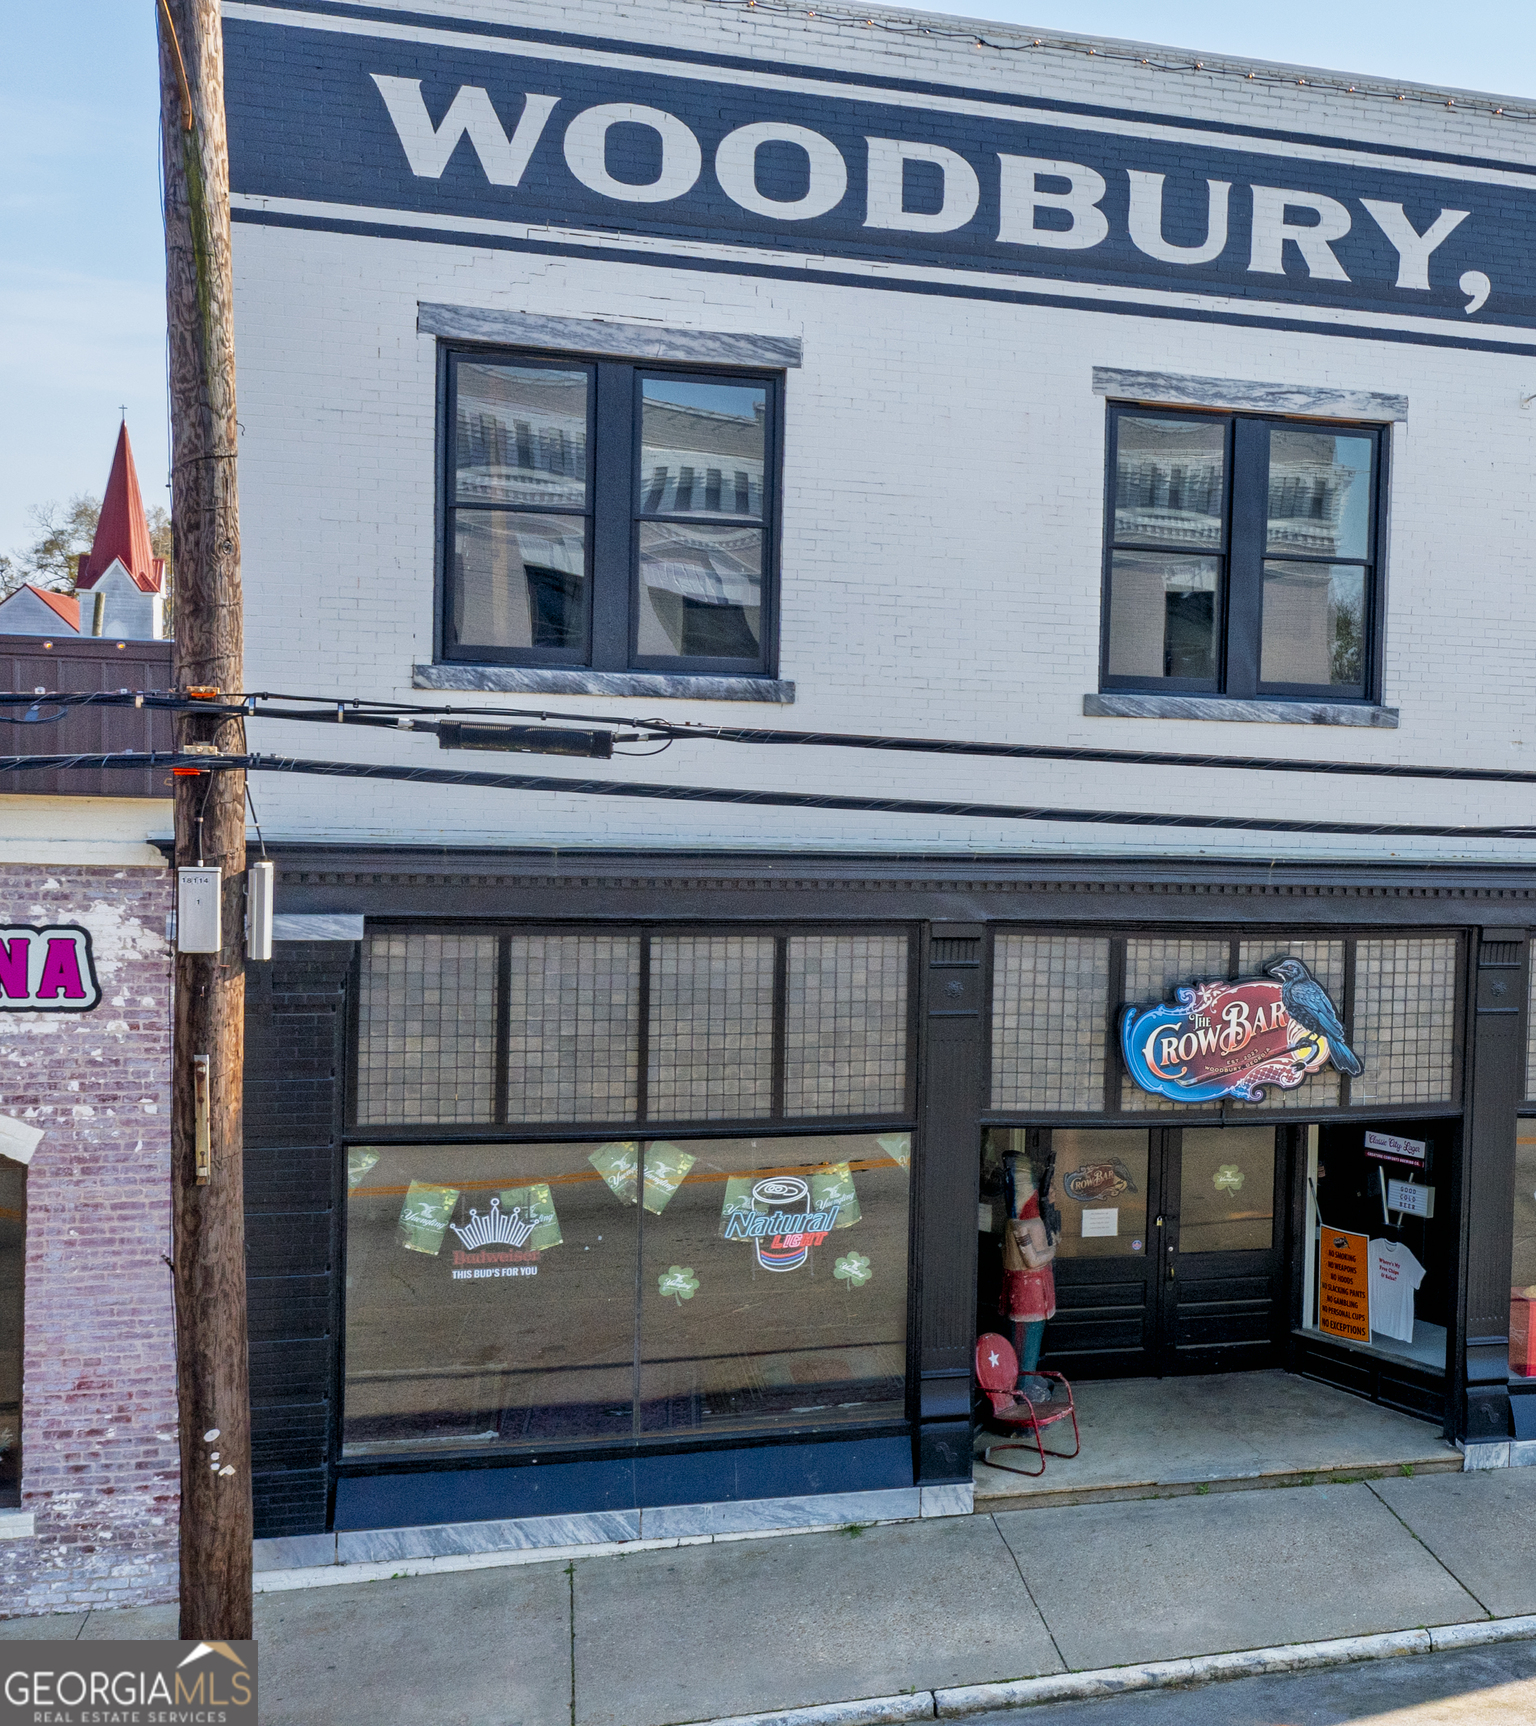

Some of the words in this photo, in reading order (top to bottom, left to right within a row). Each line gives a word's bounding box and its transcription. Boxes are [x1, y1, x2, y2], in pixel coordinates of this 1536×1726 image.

[369, 73, 1491, 315] WOODBURY,
[1189, 1013, 1211, 1031] THE
[1243, 1048, 1259, 1061] 2023
[1245, 1047, 1271, 1068] GEORGIA
[1369, 1133, 1388, 1147] Classic
[1388, 1137, 1402, 1152] City
[1403, 1140, 1421, 1155] Lager
[1400, 1186, 1417, 1194] GOOD
[1399, 1194, 1416, 1202] COLD
[1399, 1202, 1416, 1210] BEER
[401, 1208, 449, 1229] Yuengling
[724, 1205, 840, 1239] Natural
[770, 1231, 828, 1249] LIGHT
[452, 1250, 541, 1265] Budweiser
[1335, 1251, 1356, 1262] SMOKING
[452, 1269, 472, 1279] THIS
[473, 1268, 500, 1278] BUD'S
[501, 1267, 519, 1277] FOR
[520, 1266, 538, 1276] YOU
[1334, 1262, 1357, 1274] WEAPONS
[1337, 1274, 1353, 1285] HOODS
[1322, 1282, 1327, 1290] NO
[1327, 1283, 1348, 1296] SLACKING
[1349, 1288, 1365, 1298] PANTS
[1333, 1297, 1358, 1309] GAMBLING
[1322, 1305, 1328, 1313] NO
[1328, 1307, 1351, 1319] PERSONAL
[1352, 1313, 1365, 1321] CUPS
[1322, 1318, 1329, 1327] NO
[1330, 1319, 1366, 1336] EXCEPTIONS
